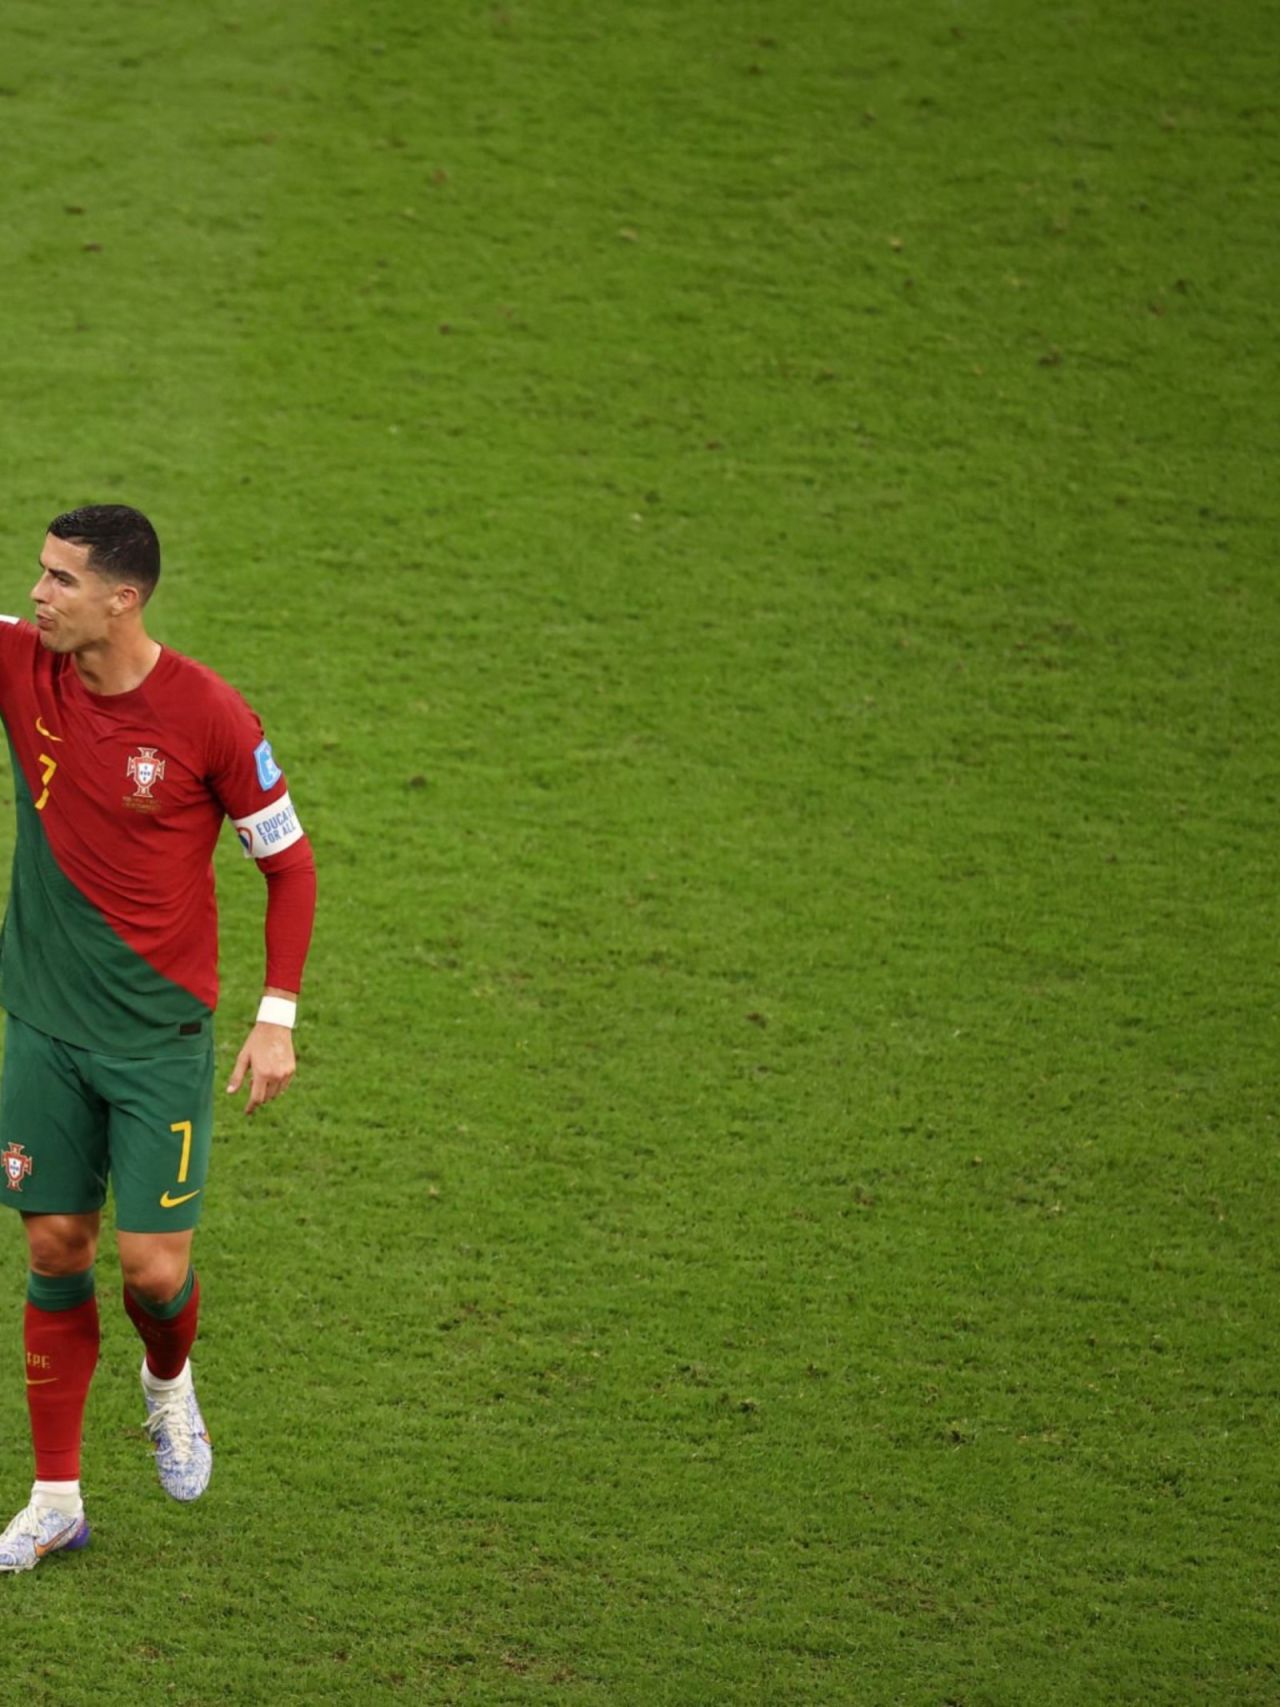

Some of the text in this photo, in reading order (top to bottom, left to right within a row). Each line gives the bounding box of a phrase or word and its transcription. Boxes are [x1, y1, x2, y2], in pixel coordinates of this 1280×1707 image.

[35, 753, 57, 810] 7
[262, 820, 297, 846] FOR ALL
[170, 1120, 191, 1183] 7
